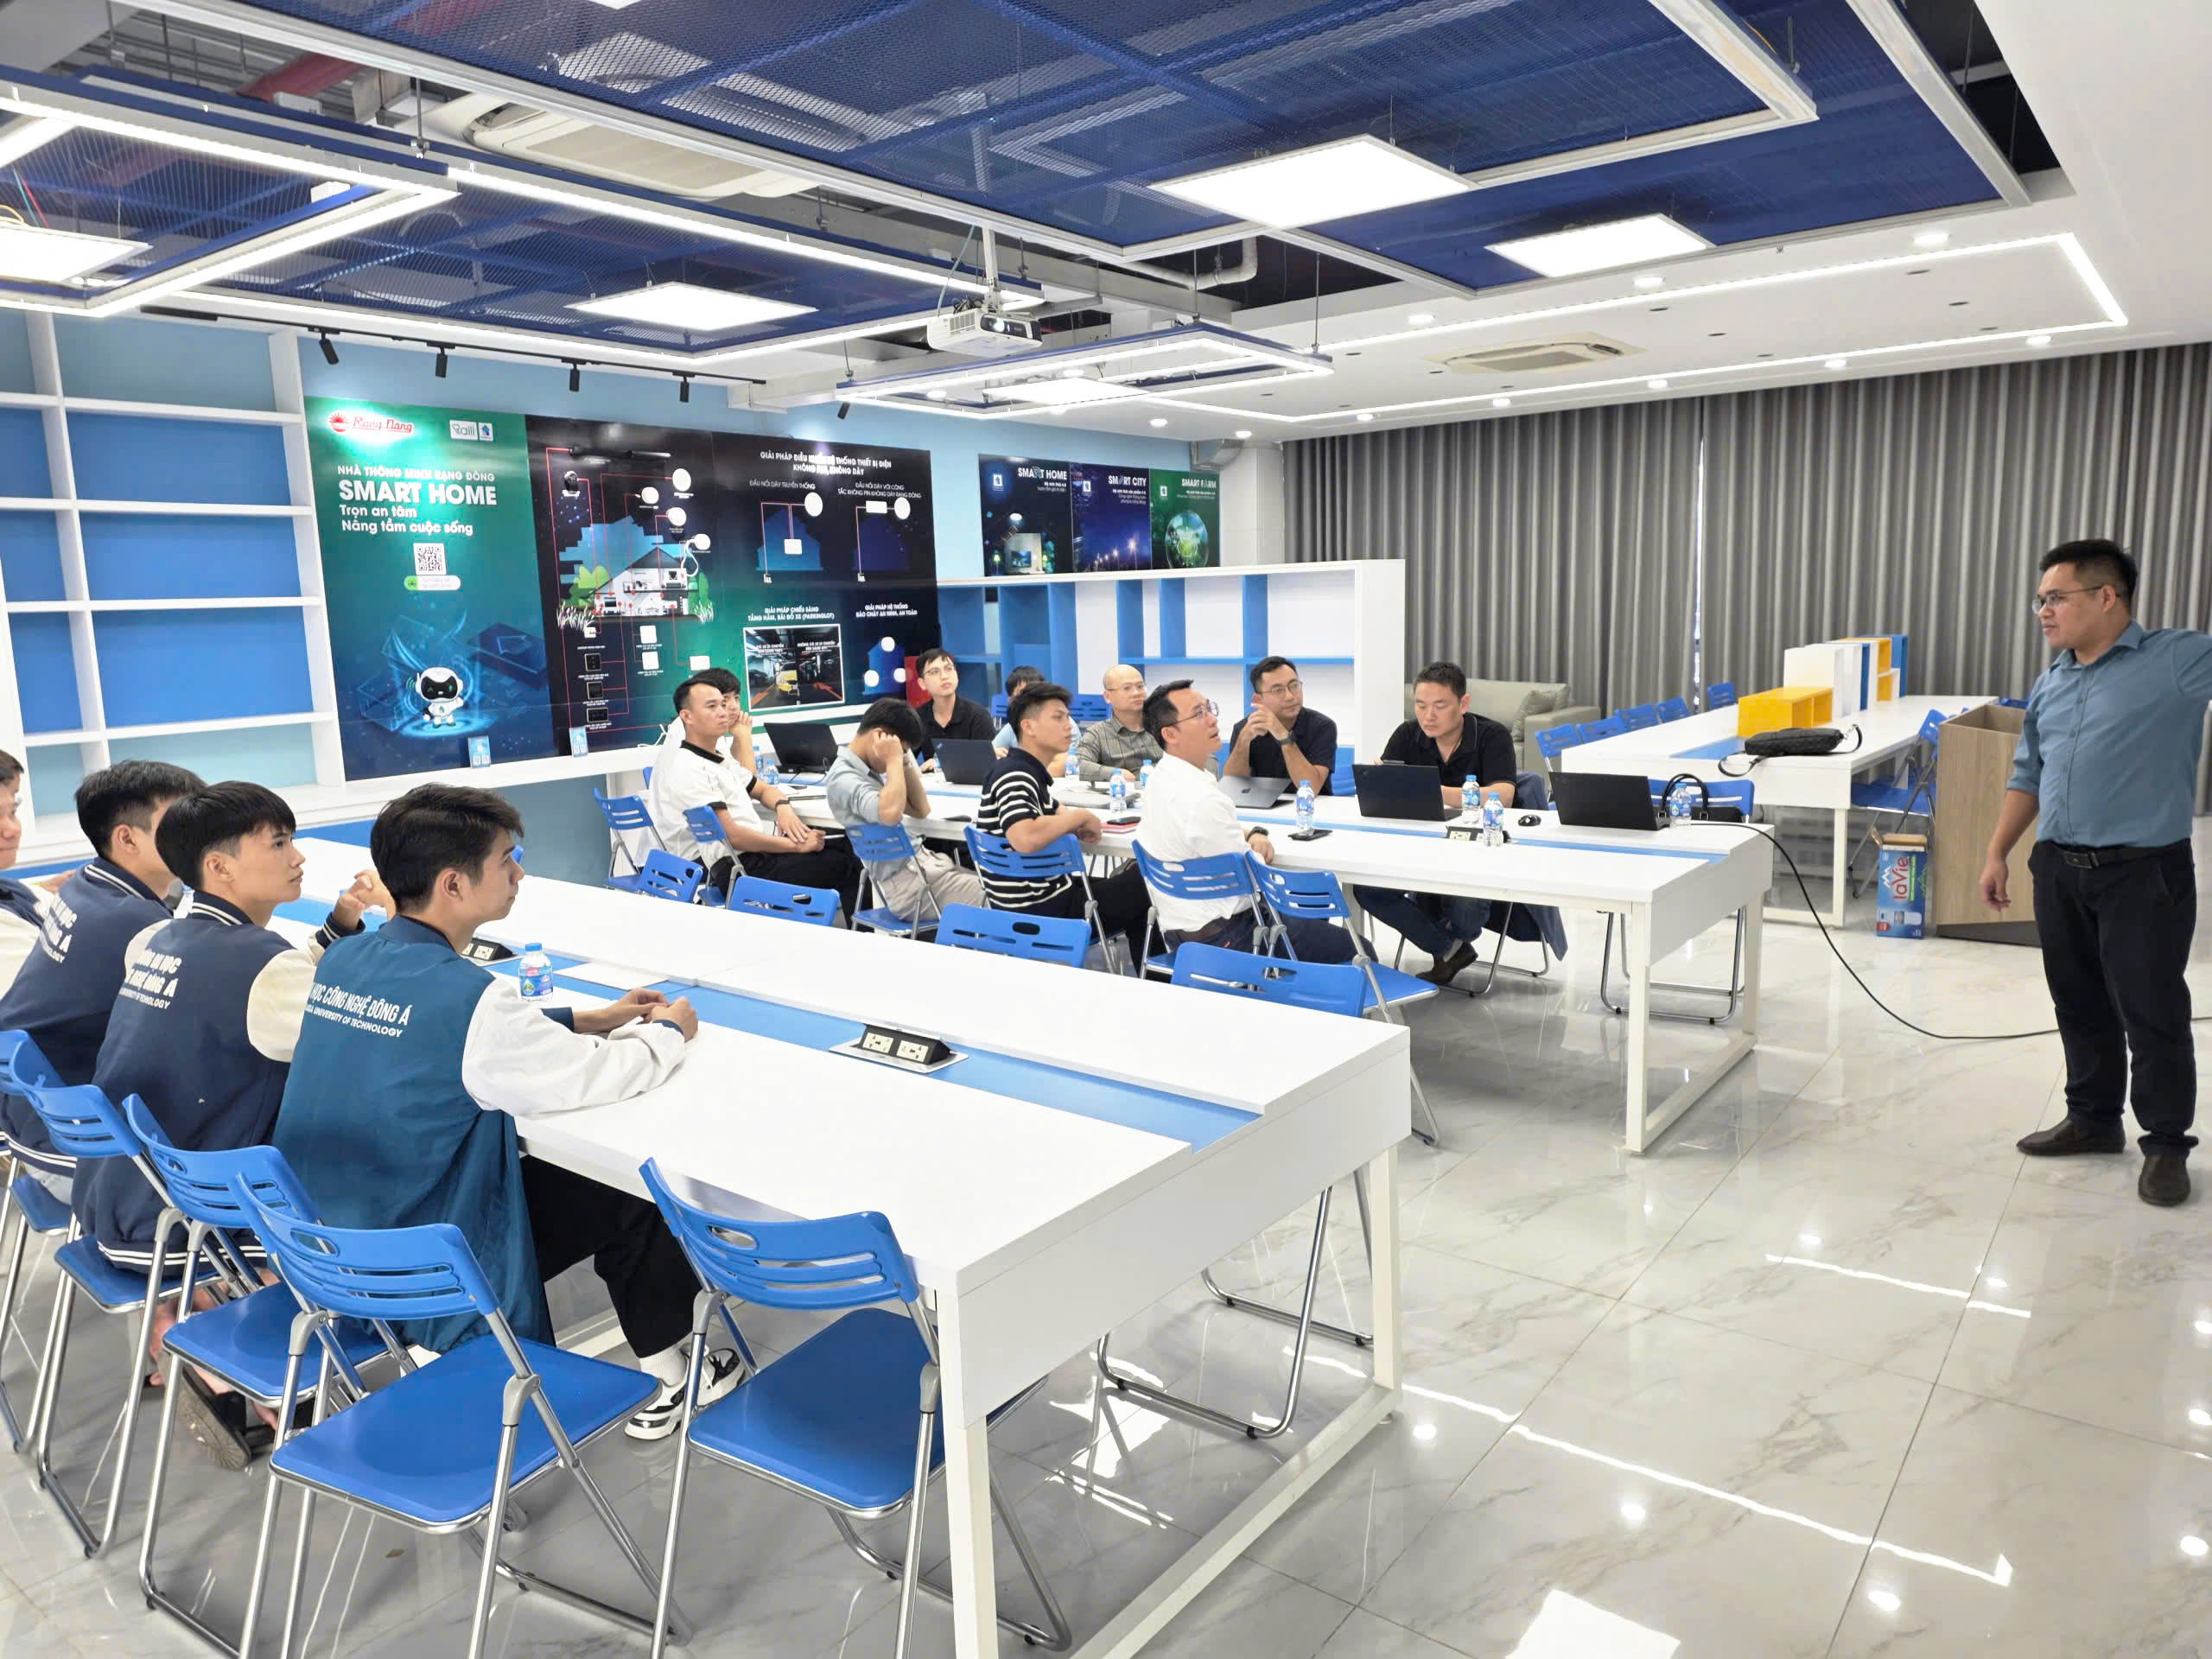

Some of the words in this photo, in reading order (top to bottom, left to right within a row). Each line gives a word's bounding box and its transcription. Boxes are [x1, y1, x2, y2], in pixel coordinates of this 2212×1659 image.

[760, 450, 774, 460] GIẢI
[775, 451, 792, 461] PHÁP
[836, 455, 856, 466] THỐNG
[857, 456, 872, 467] THIẾT
[337, 463, 362, 476] NHÀ
[363, 464, 403, 478] THÔNG
[404, 468, 433, 480] MINH
[434, 469, 463, 483] RẠNG
[792, 463, 816, 473] KHÔNG
[852, 466, 865, 475] DÂY
[1046, 469, 1068, 480] HOME
[1132, 477, 1147, 486] CITY
[1181, 478, 1200, 487] SMART
[338, 480, 422, 504] SMART
[428, 483, 498, 505] HOME
[339, 504, 368, 519] Trọn
[371, 506, 389, 517] an
[391, 505, 417, 518] tâm
[341, 519, 378, 535] Nâng
[380, 518, 406, 532] tầm
[409, 520, 442, 536] cuộc
[443, 519, 474, 537] sống
[162, 977, 179, 997] Á
[322, 985, 349, 1008] CÔNG
[343, 992, 372, 1018] NGHỆ
[366, 998, 400, 1022] ĐÔNG
[397, 1004, 413, 1026] Á
[313, 1006, 343, 1022] UNIVERSITY
[342, 1015, 351, 1025] OF
[350, 1017, 403, 1037] TECHNOLOGY
